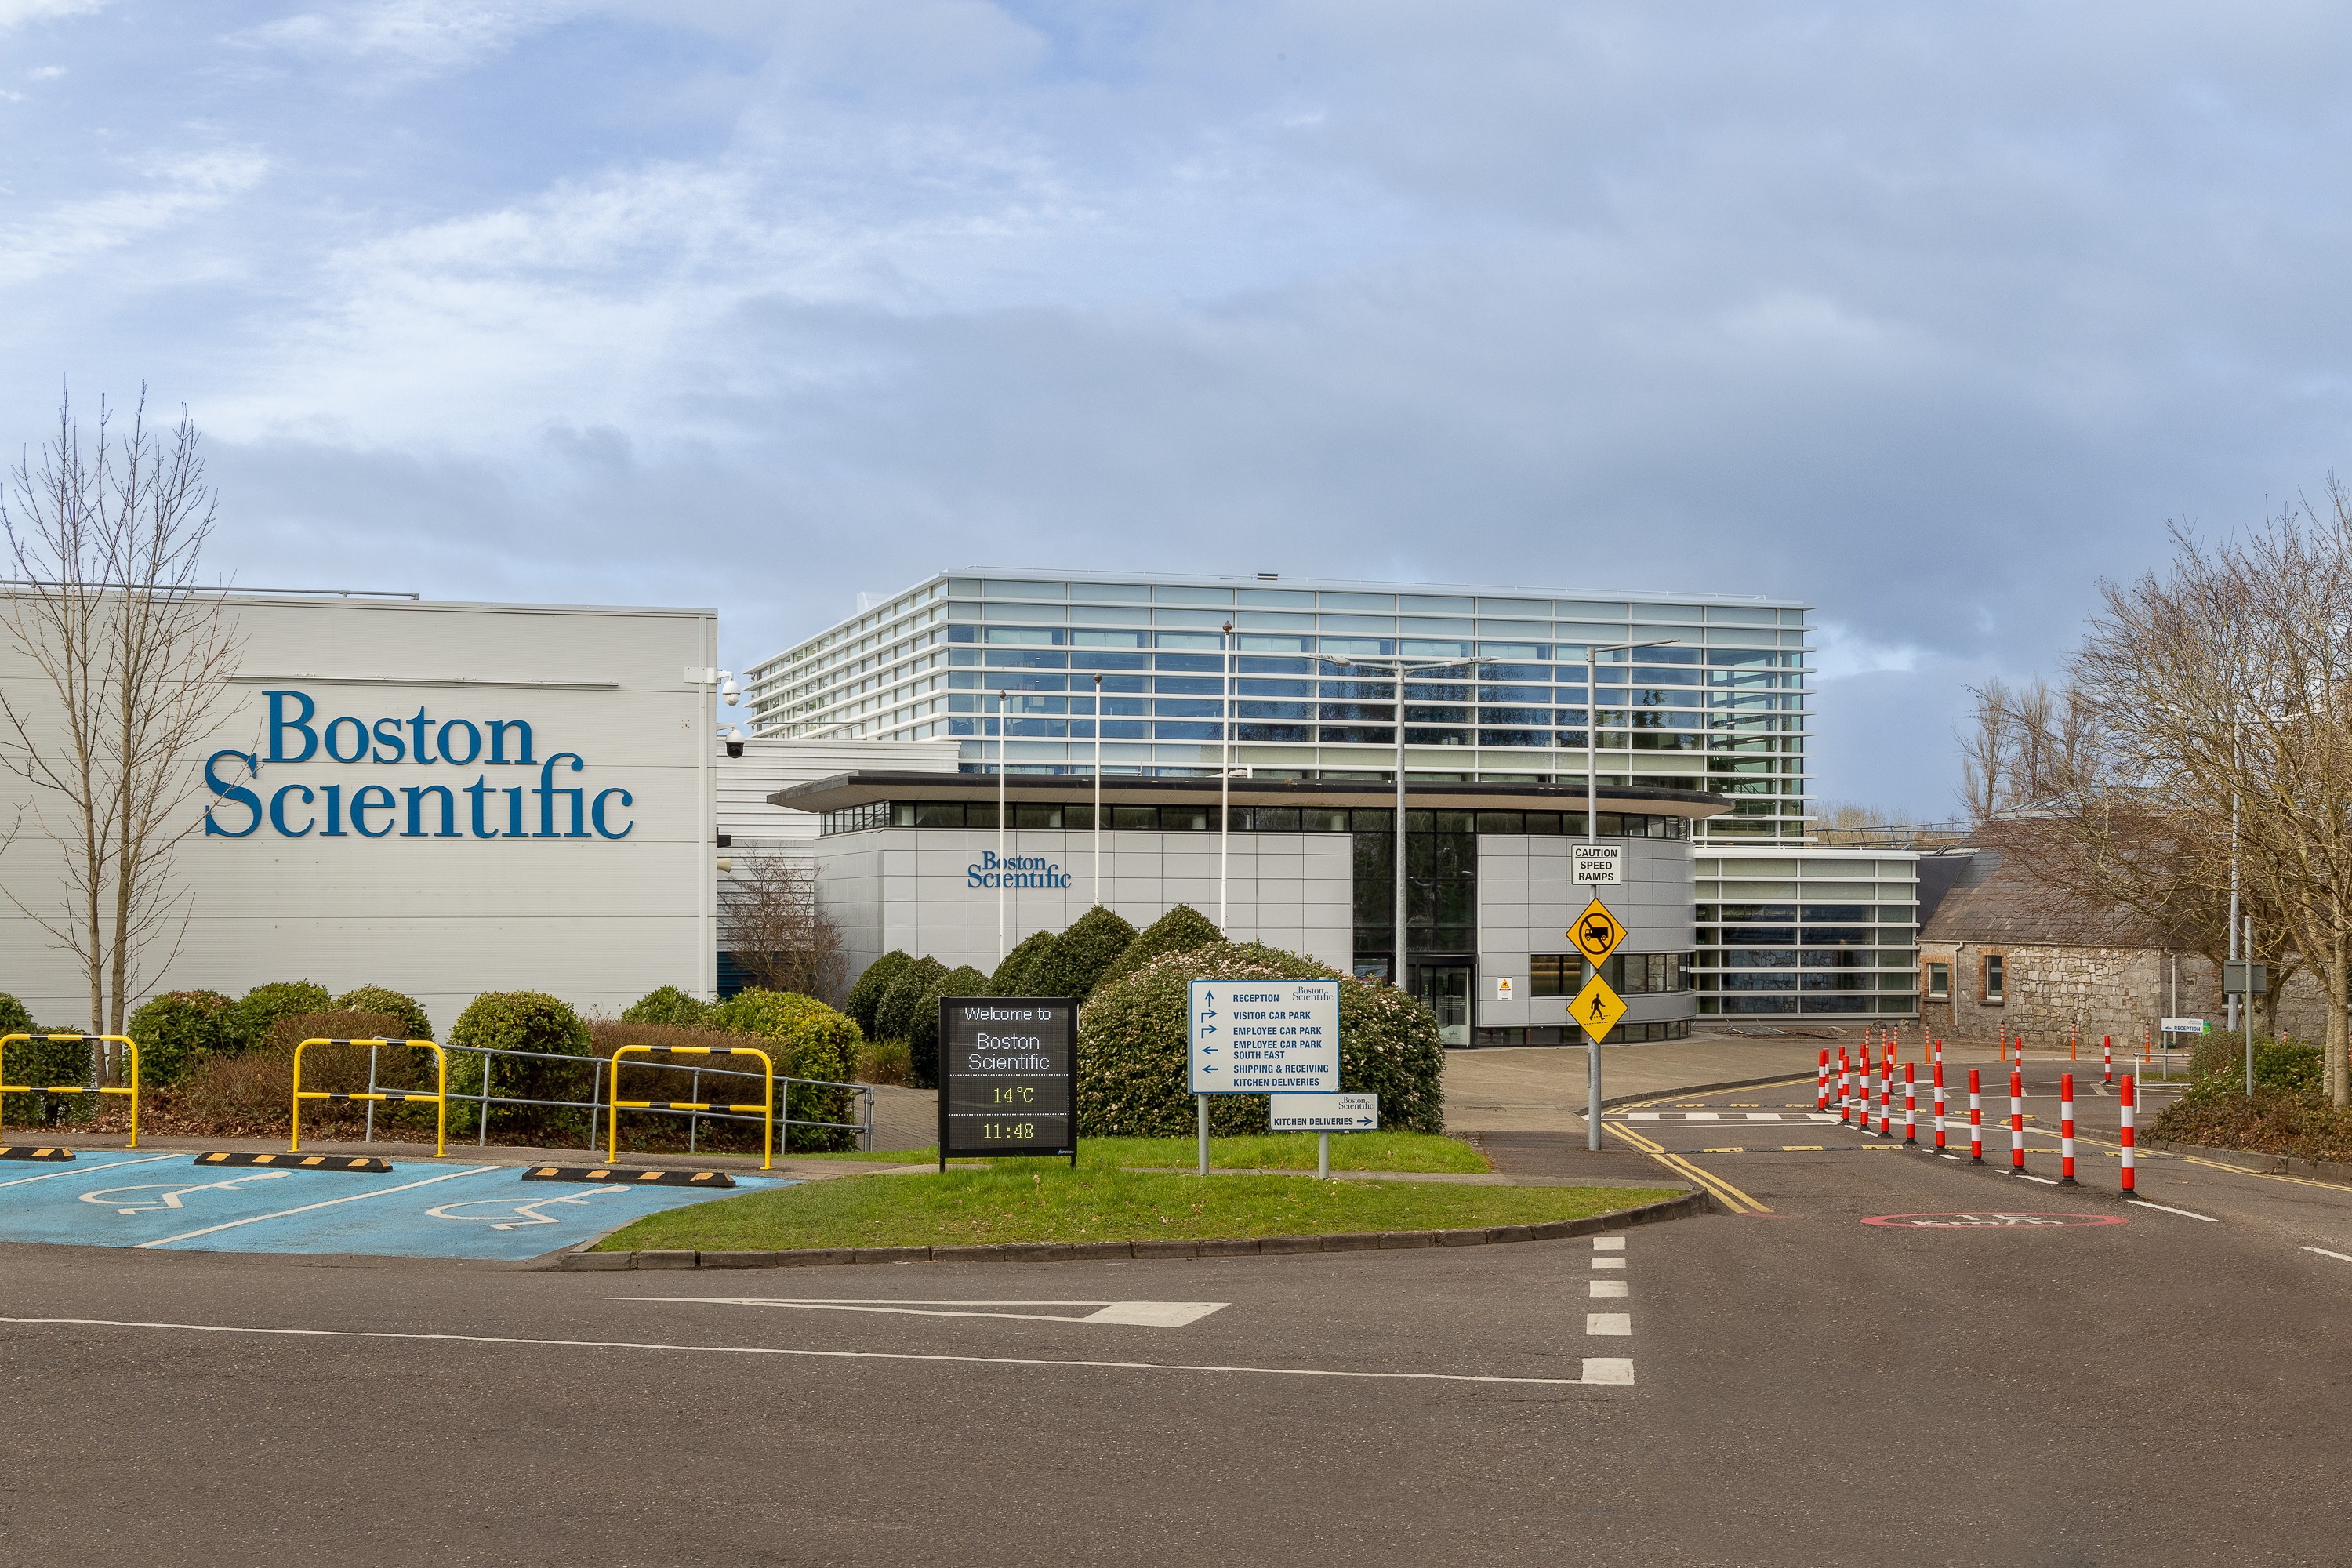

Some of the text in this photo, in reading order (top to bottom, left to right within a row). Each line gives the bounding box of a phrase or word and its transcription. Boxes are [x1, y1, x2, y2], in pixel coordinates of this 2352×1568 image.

[261, 690, 538, 766] Boston
[204, 750, 634, 839] Scientific
[1575, 848, 1617, 857] CAUTION
[982, 851, 1047, 870] Boston
[1580, 861, 1613, 869] SPEED
[967, 863, 1072, 888] Scientific
[1578, 872, 1614, 881] RAMPS
[1232, 994, 1279, 1003] RECEPTION
[1292, 991, 1334, 1001] Scientific
[964, 1006, 1051, 1021] Welcome to
[1233, 1011, 1311, 1020] VISITOR CAR PARK
[1233, 1027, 1278, 1036] EMPLOYEE
[1299, 1026, 1322, 1035] PARK
[977, 1033, 1040, 1050] Boston
[1233, 1040, 1278, 1049] EMPLOYEE
[1233, 1051, 1285, 1059] SOUTH EAST
[968, 1053, 1050, 1070] Scientific
[1233, 1064, 1329, 1073] SHIPPING & RECEIVING
[1233, 1078, 1319, 1087] KITCHEN DELIVERIES
[1338, 1101, 1374, 1109] Scientific
[1309, 1117, 1353, 1126] DELIVERIES
[984, 1123, 1033, 1139] 11:48
